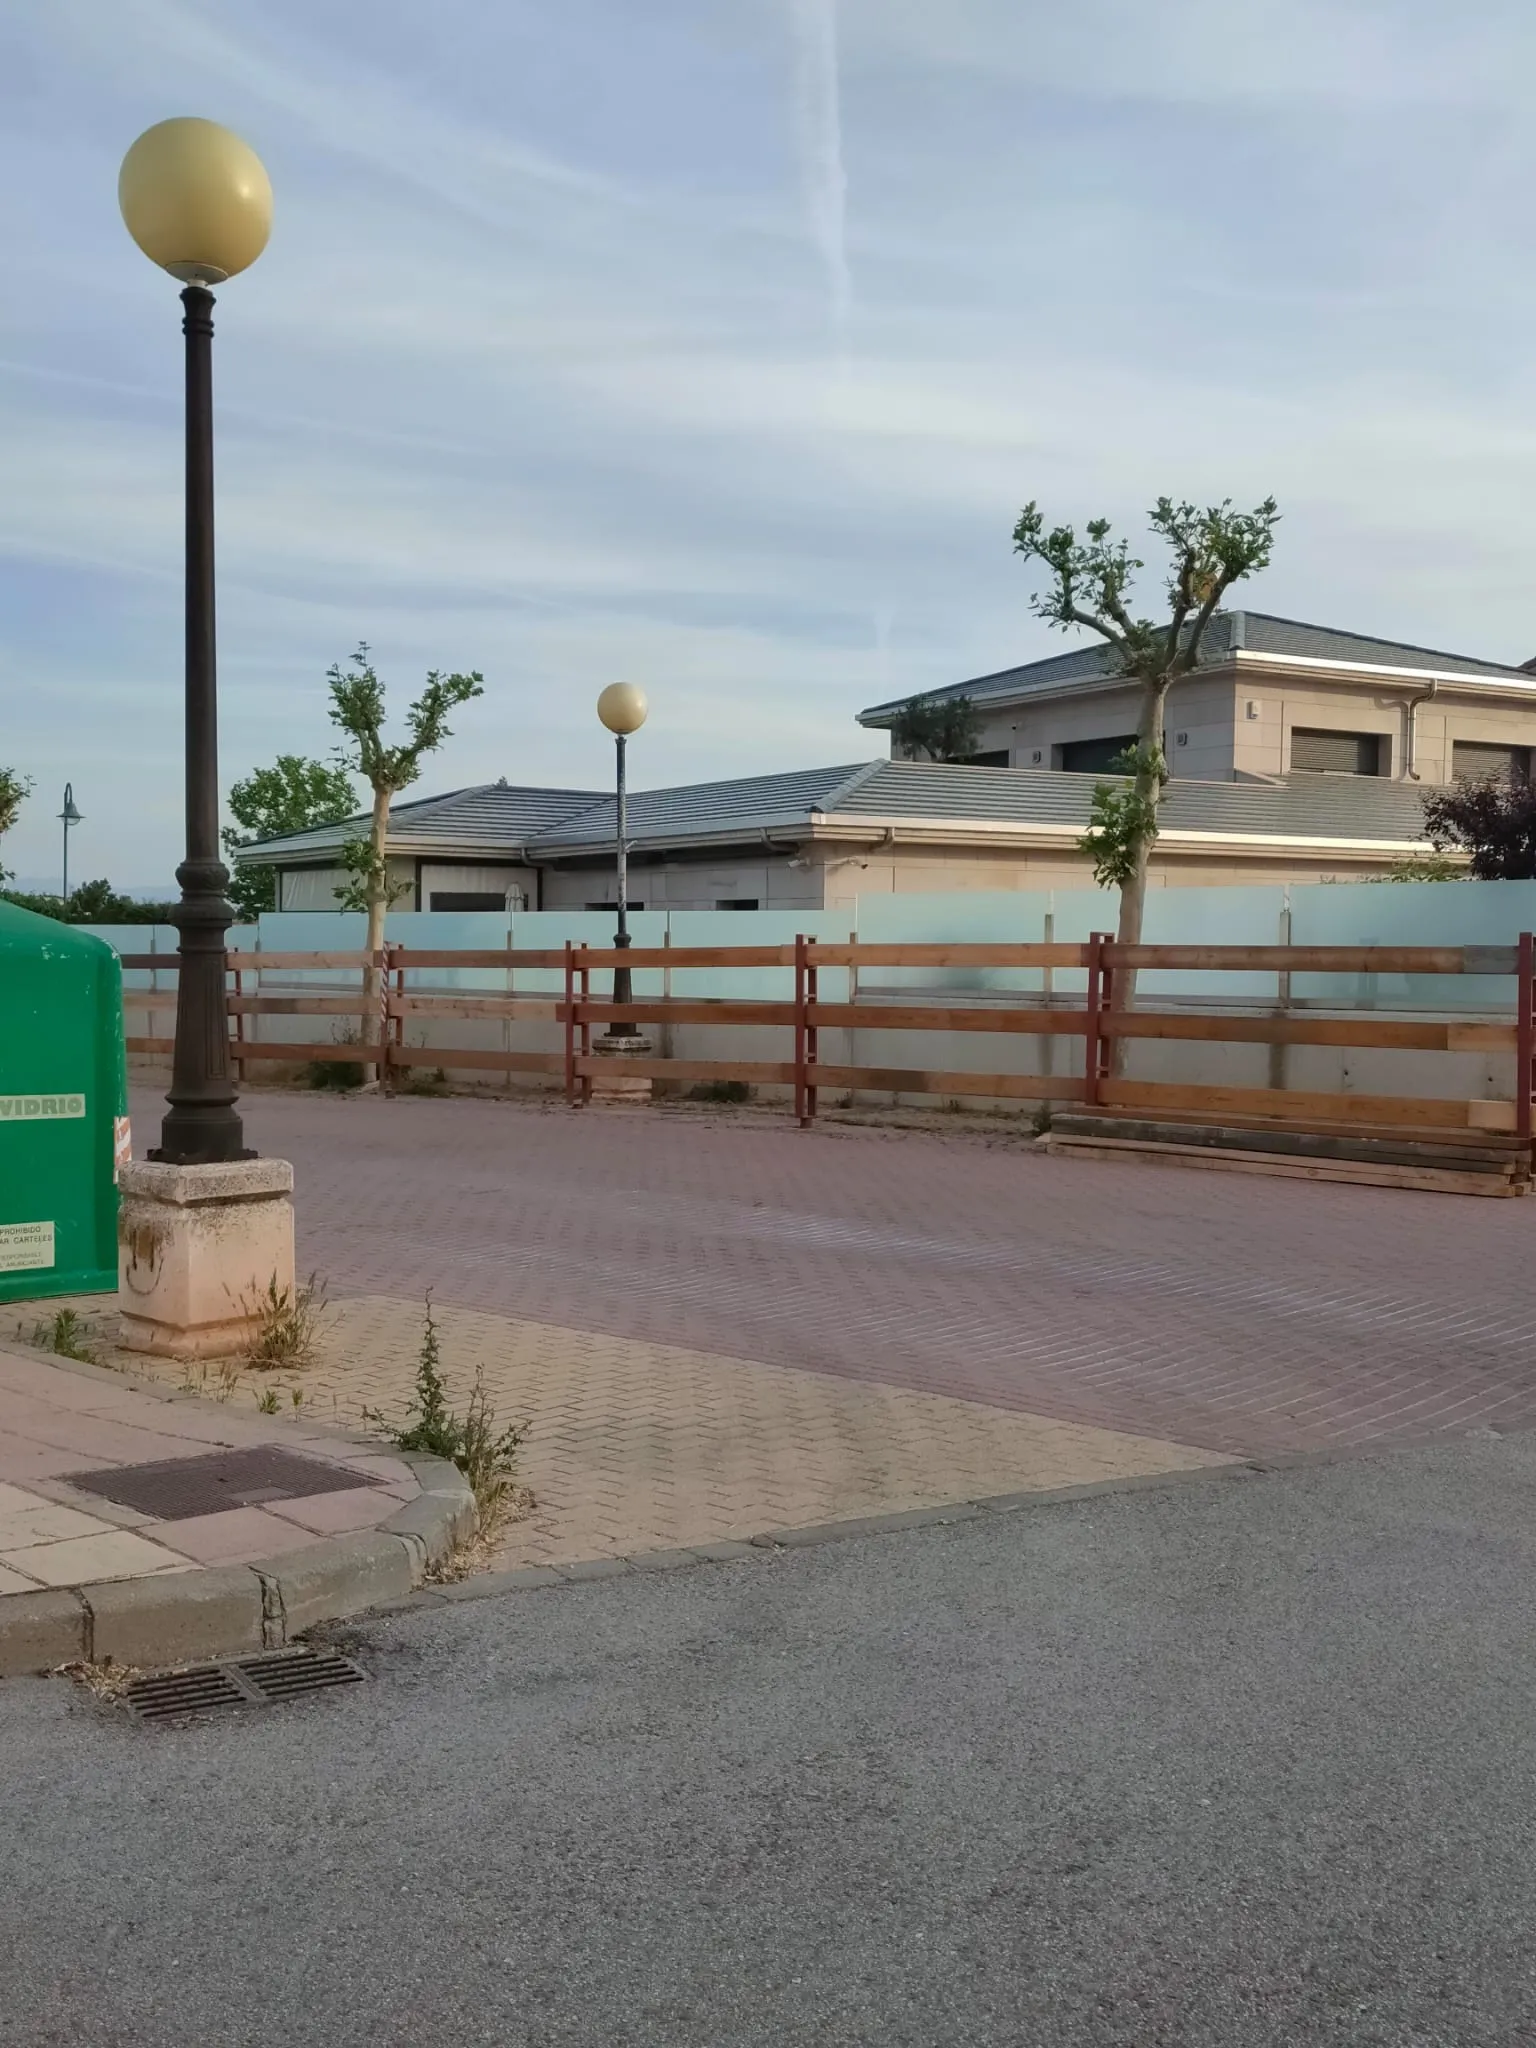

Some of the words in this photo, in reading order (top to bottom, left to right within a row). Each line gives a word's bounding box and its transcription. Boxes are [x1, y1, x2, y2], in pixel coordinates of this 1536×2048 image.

[0, 1097, 82, 1116] VIDRIO
[0, 1225, 41, 1236] PROHIBIDO
[13, 1234, 52, 1245] CARTELES
